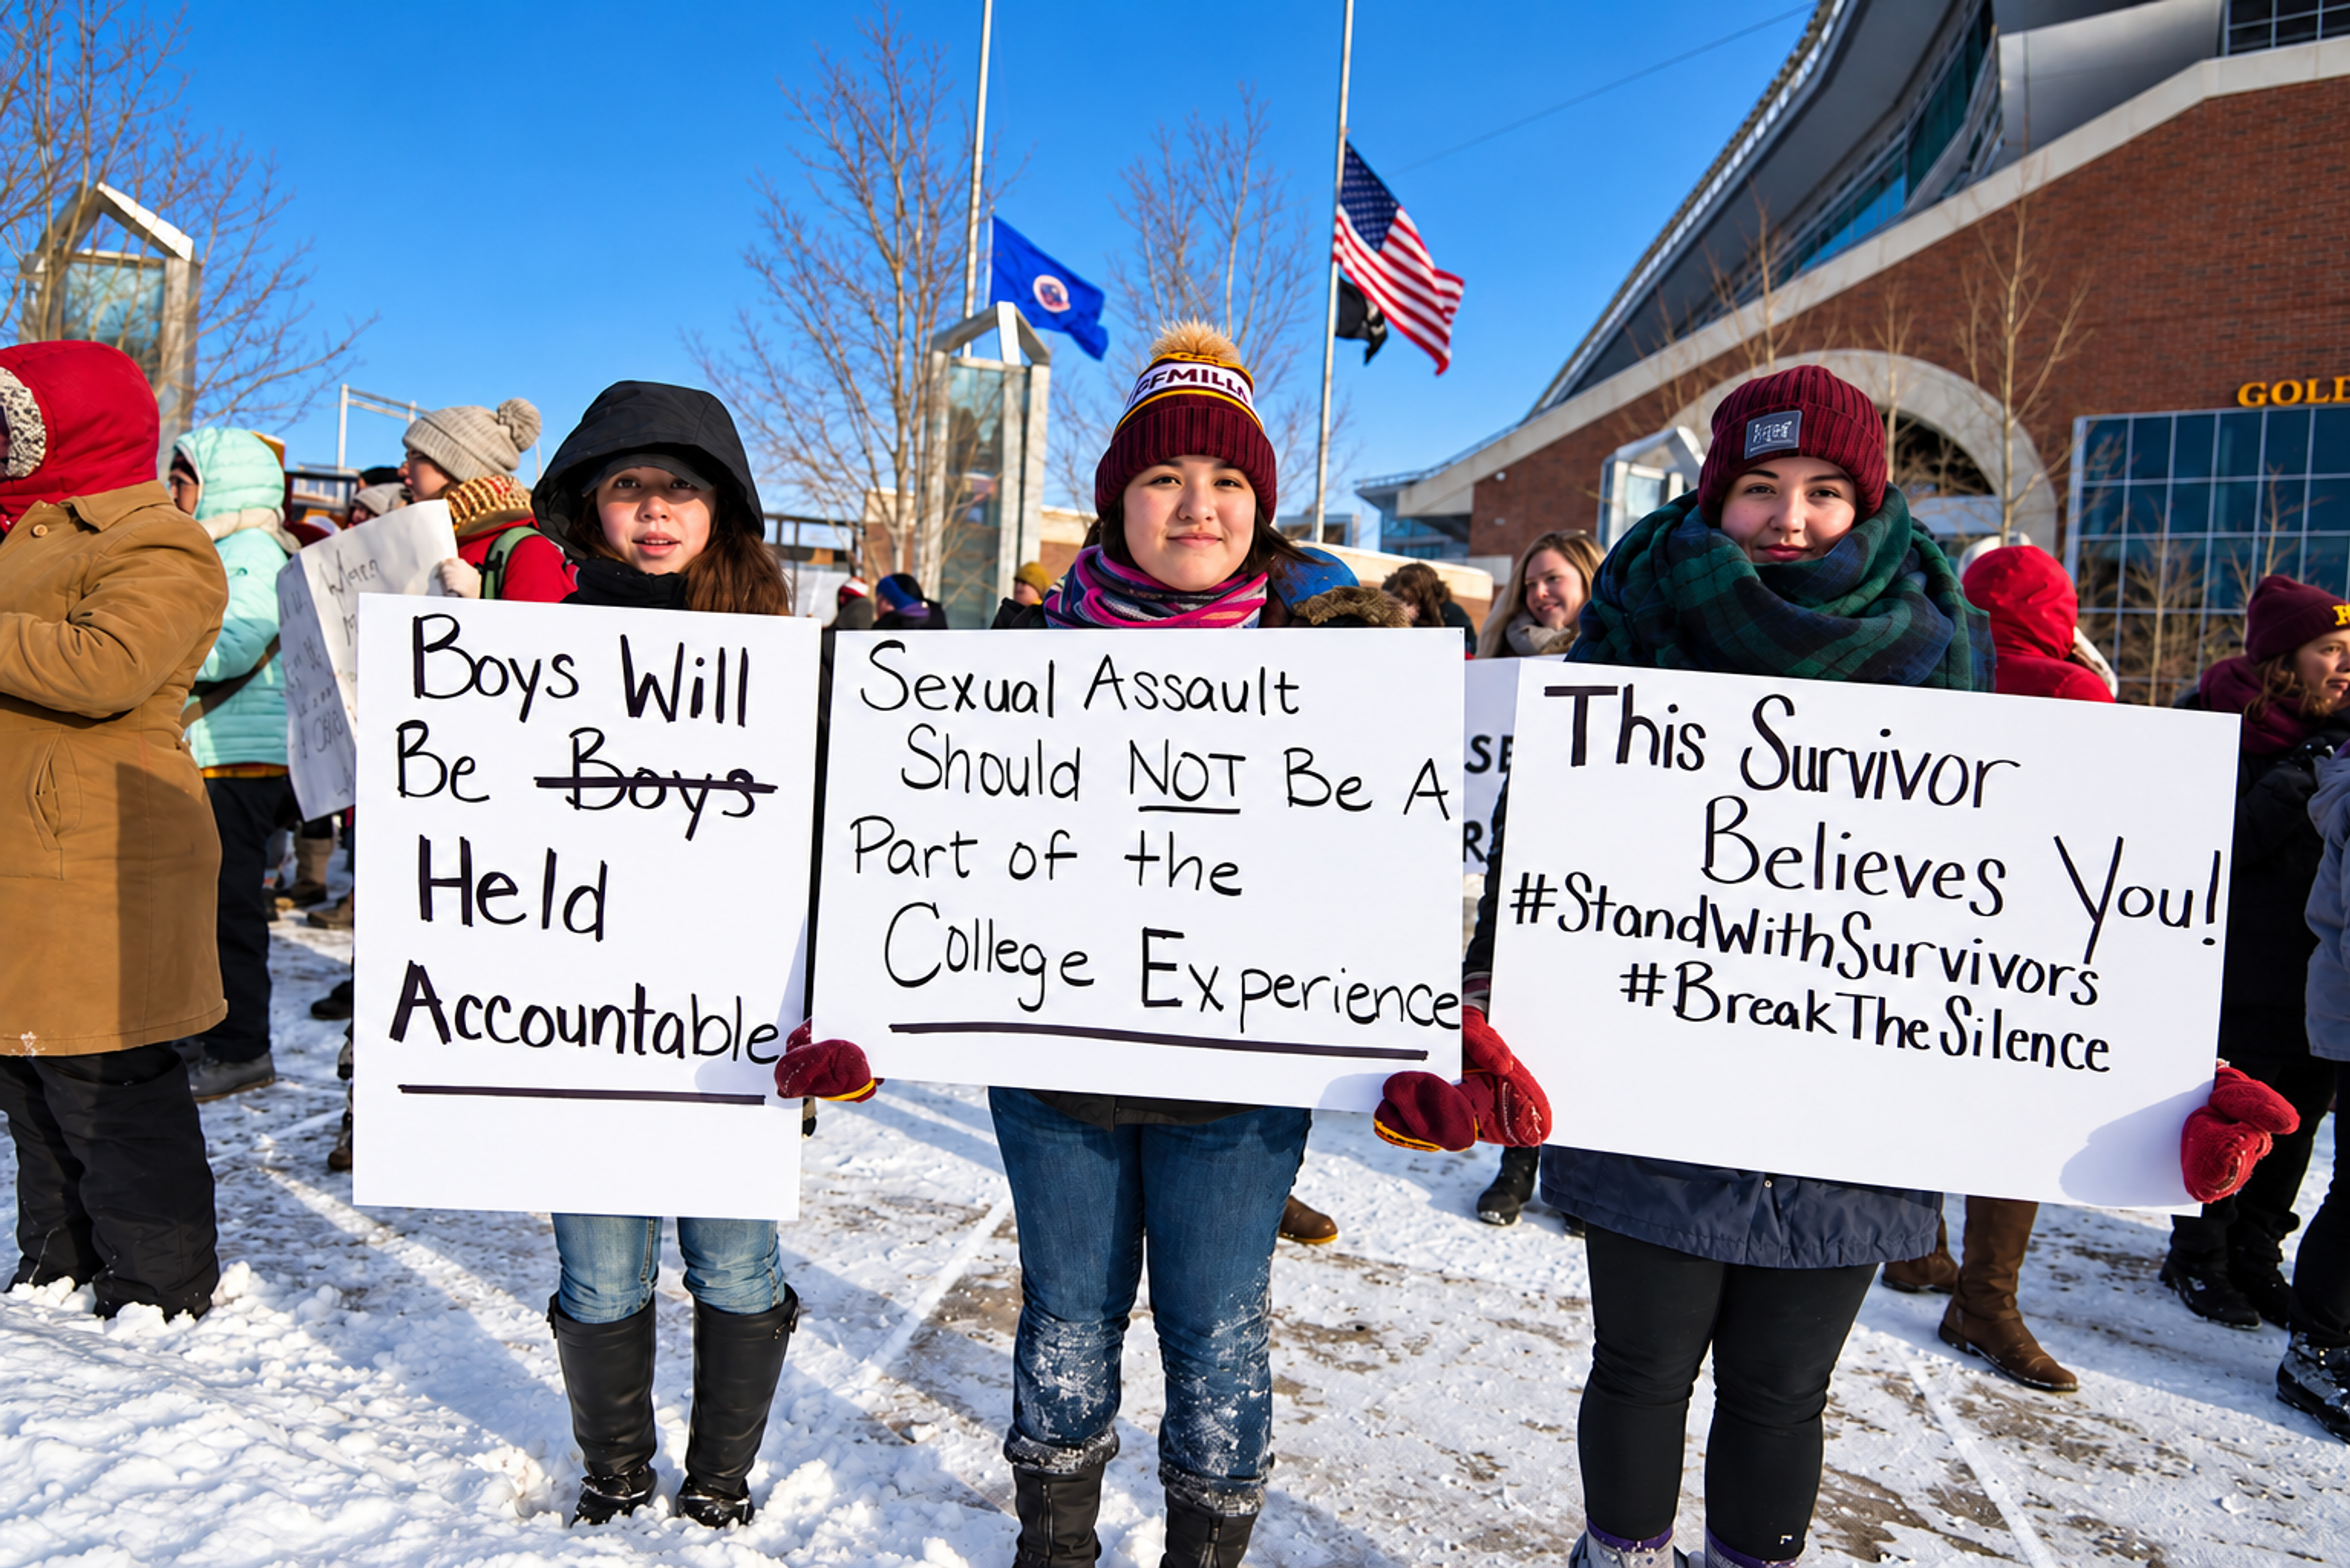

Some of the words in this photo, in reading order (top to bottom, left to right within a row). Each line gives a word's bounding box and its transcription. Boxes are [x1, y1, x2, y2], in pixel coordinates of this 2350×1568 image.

[413, 614, 578, 723] Boys
[621, 635, 748, 727] Will
[861, 640, 1054, 718] Sexual
[1084, 654, 1299, 715] Assault
[397, 720, 490, 802] Be
[566, 728, 755, 841] Boys
[901, 723, 1080, 801] Should
[1130, 739, 1245, 801] NOT
[1284, 748, 1372, 812] Be
[1404, 758, 1449, 820] A
[1545, 684, 1706, 771] This
[1740, 694, 2020, 807] Survivor
[419, 835, 607, 942] Held
[851, 816, 977, 878] Part
[1009, 830, 1077, 880] of
[1125, 831, 1242, 896] the
[1701, 796, 2005, 916] Believes
[2054, 836, 2220, 965] You!
[885, 902, 1094, 1012] College
[1142, 927, 1460, 1033] Experience
[1510, 872, 2098, 1006] #StandWithSurvivors
[389, 960, 780, 1064] Accountable
[1620, 961, 2109, 1072] #BreakTheSilence
